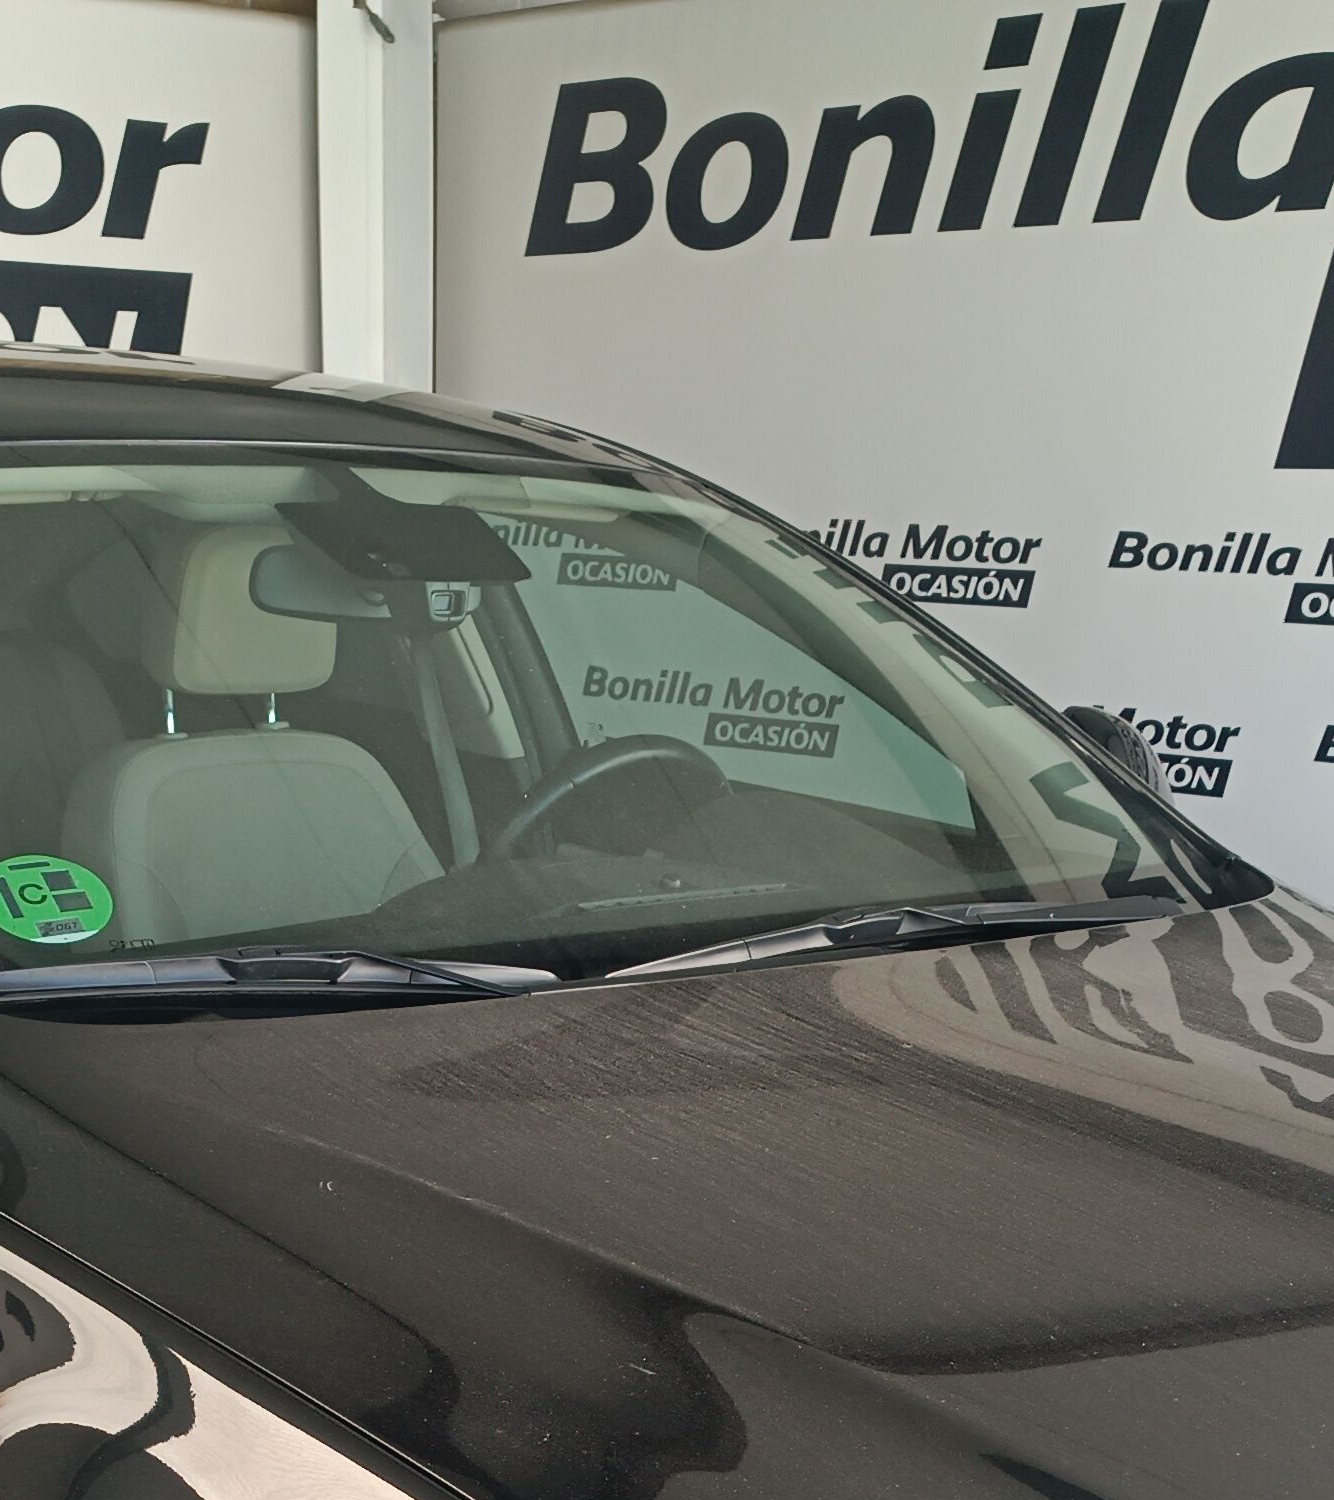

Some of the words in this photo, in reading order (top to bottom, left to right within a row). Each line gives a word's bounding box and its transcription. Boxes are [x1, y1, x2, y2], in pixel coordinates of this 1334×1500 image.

[900, 523, 1042, 564] Motor
[1108, 530, 1302, 577] Bonilla
[890, 571, 1024, 600] OCASIÓN
[582, 665, 713, 709] Bonilla
[722, 677, 844, 720] Motor
[713, 720, 831, 751] OCASIÓN
